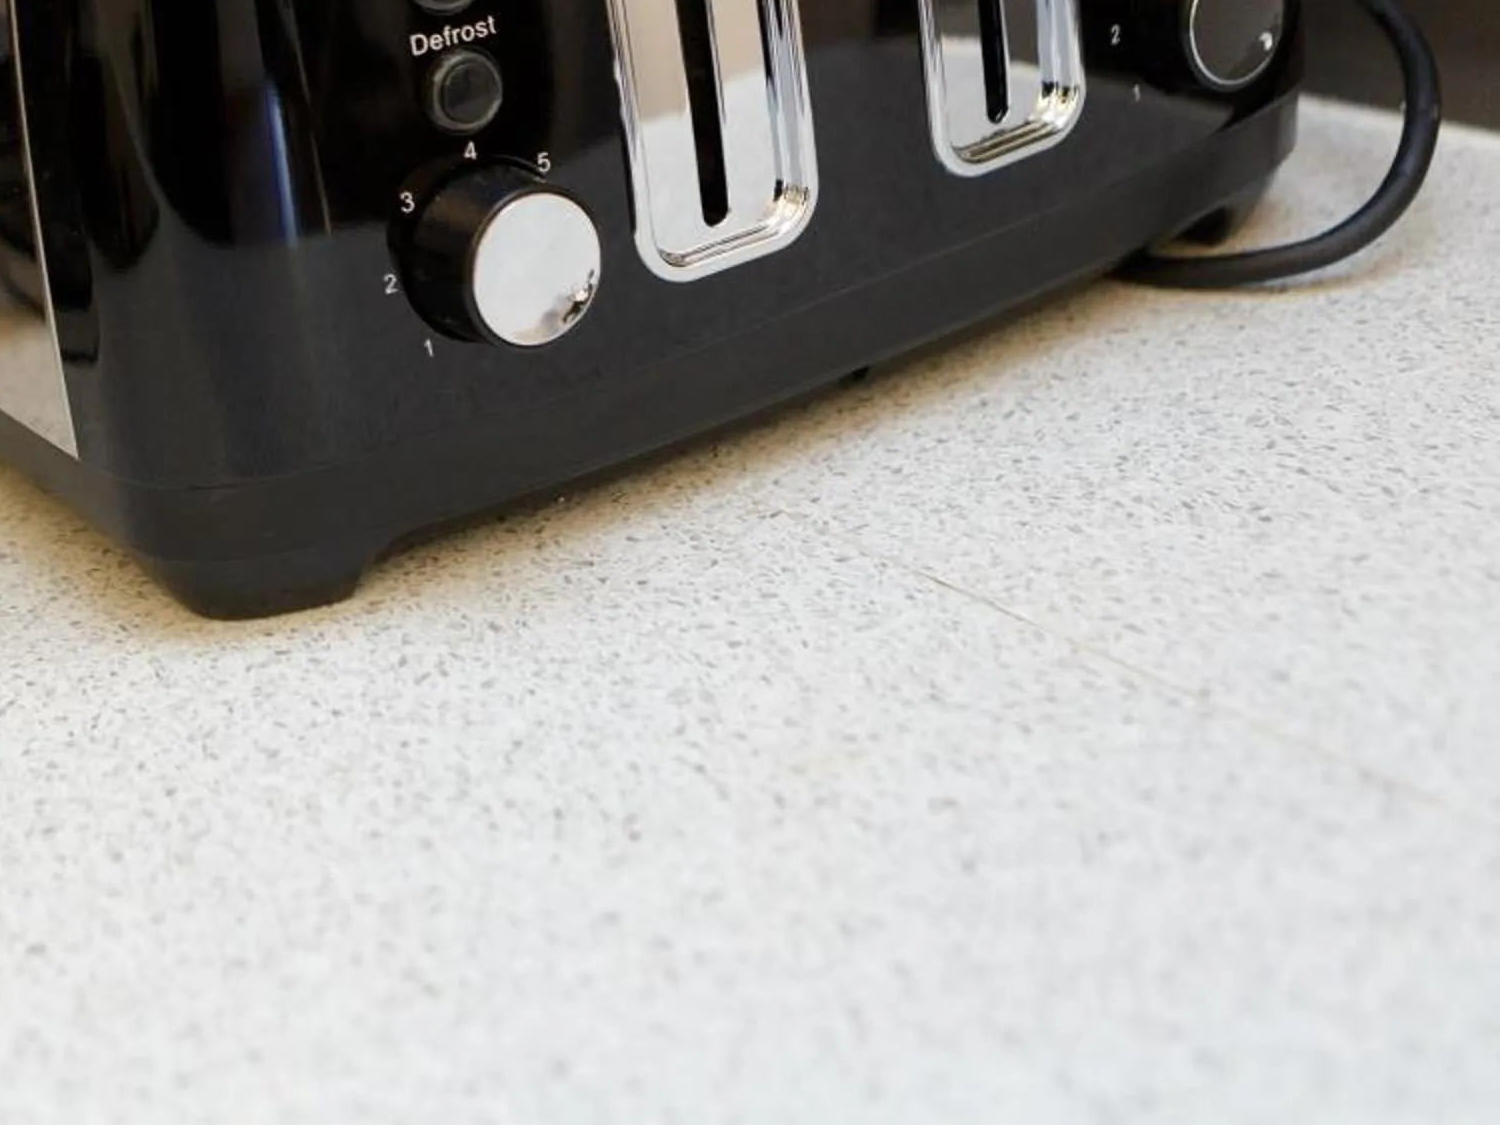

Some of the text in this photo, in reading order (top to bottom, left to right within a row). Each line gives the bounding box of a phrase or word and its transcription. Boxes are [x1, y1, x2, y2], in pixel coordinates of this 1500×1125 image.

[408, 14, 498, 57] Defrost
[1110, 24, 1121, 46] 2
[463, 141, 478, 160] 4
[536, 152, 551, 173] 5
[400, 191, 416, 214] 3
[382, 274, 399, 295] 2
[423, 338, 435, 358] 1
